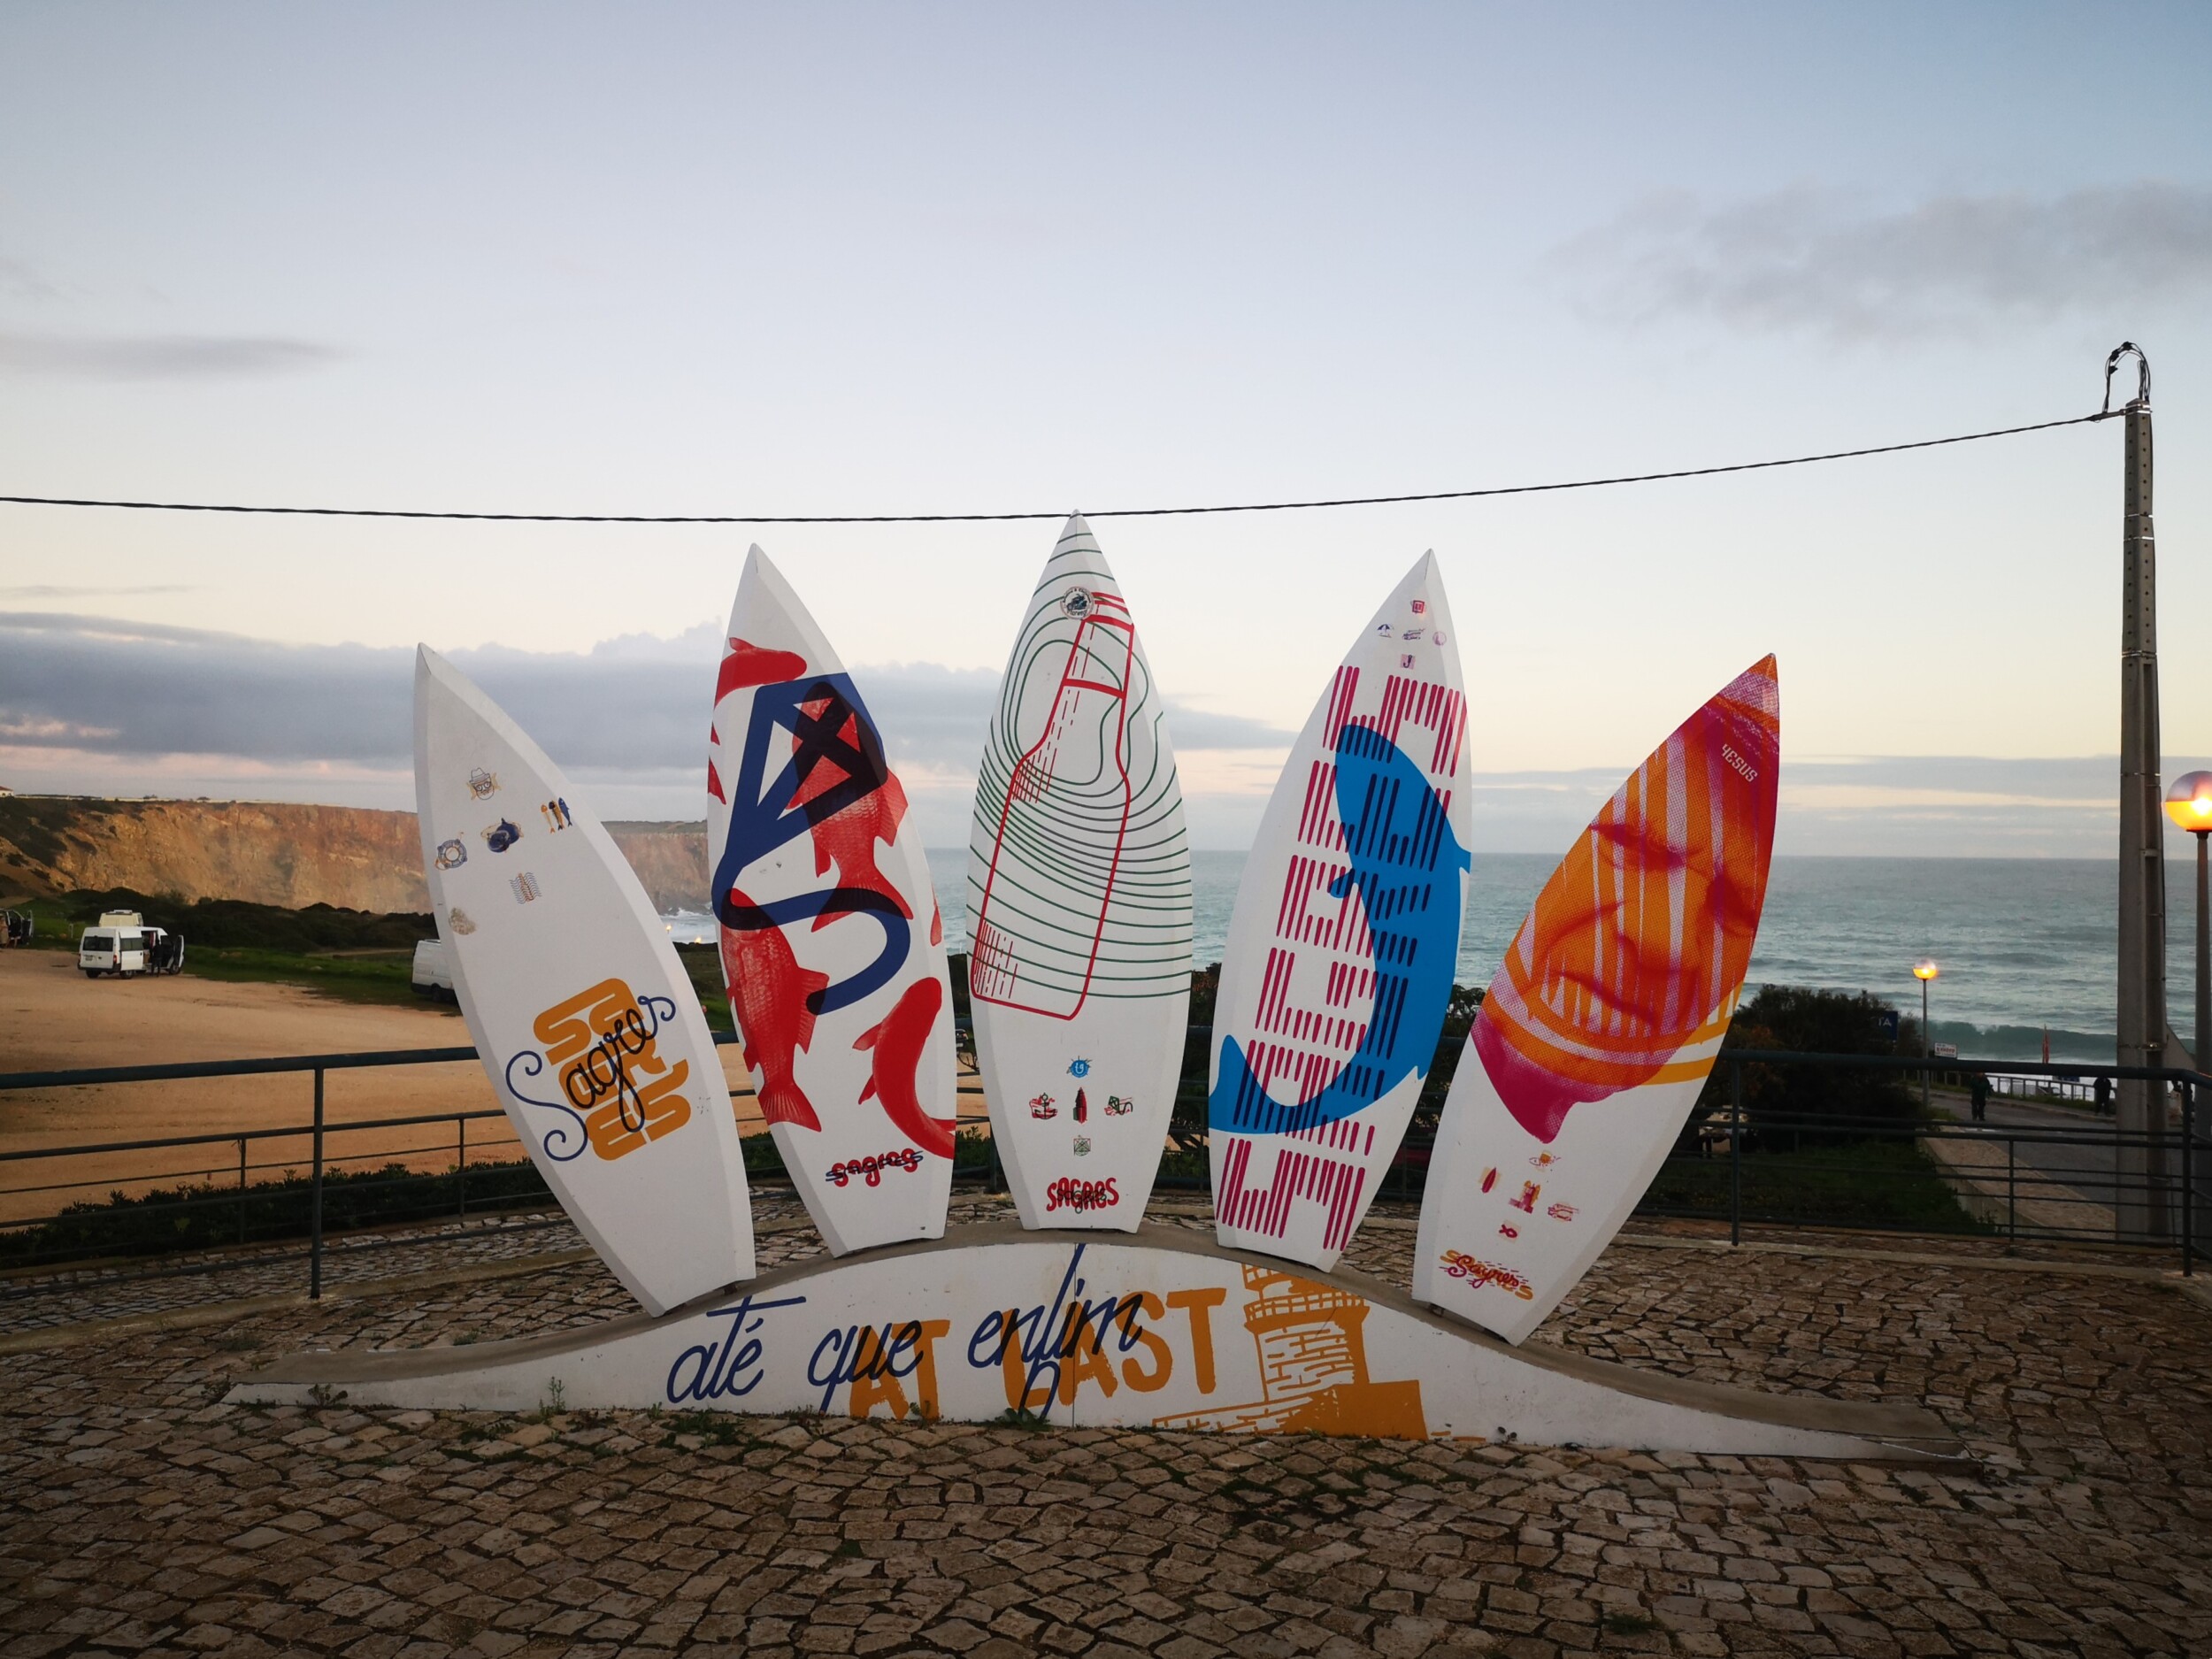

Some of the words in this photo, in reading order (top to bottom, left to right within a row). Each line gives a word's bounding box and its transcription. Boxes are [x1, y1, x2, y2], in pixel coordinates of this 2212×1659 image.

[505, 995, 677, 1162] Sagres
[666, 1294, 807, 1404] até
[807, 1319, 925, 1416] que
[967, 1242, 1144, 1419] enfim
[849, 1318, 951, 1421] AT
[999, 1286, 1227, 1410] LAST
